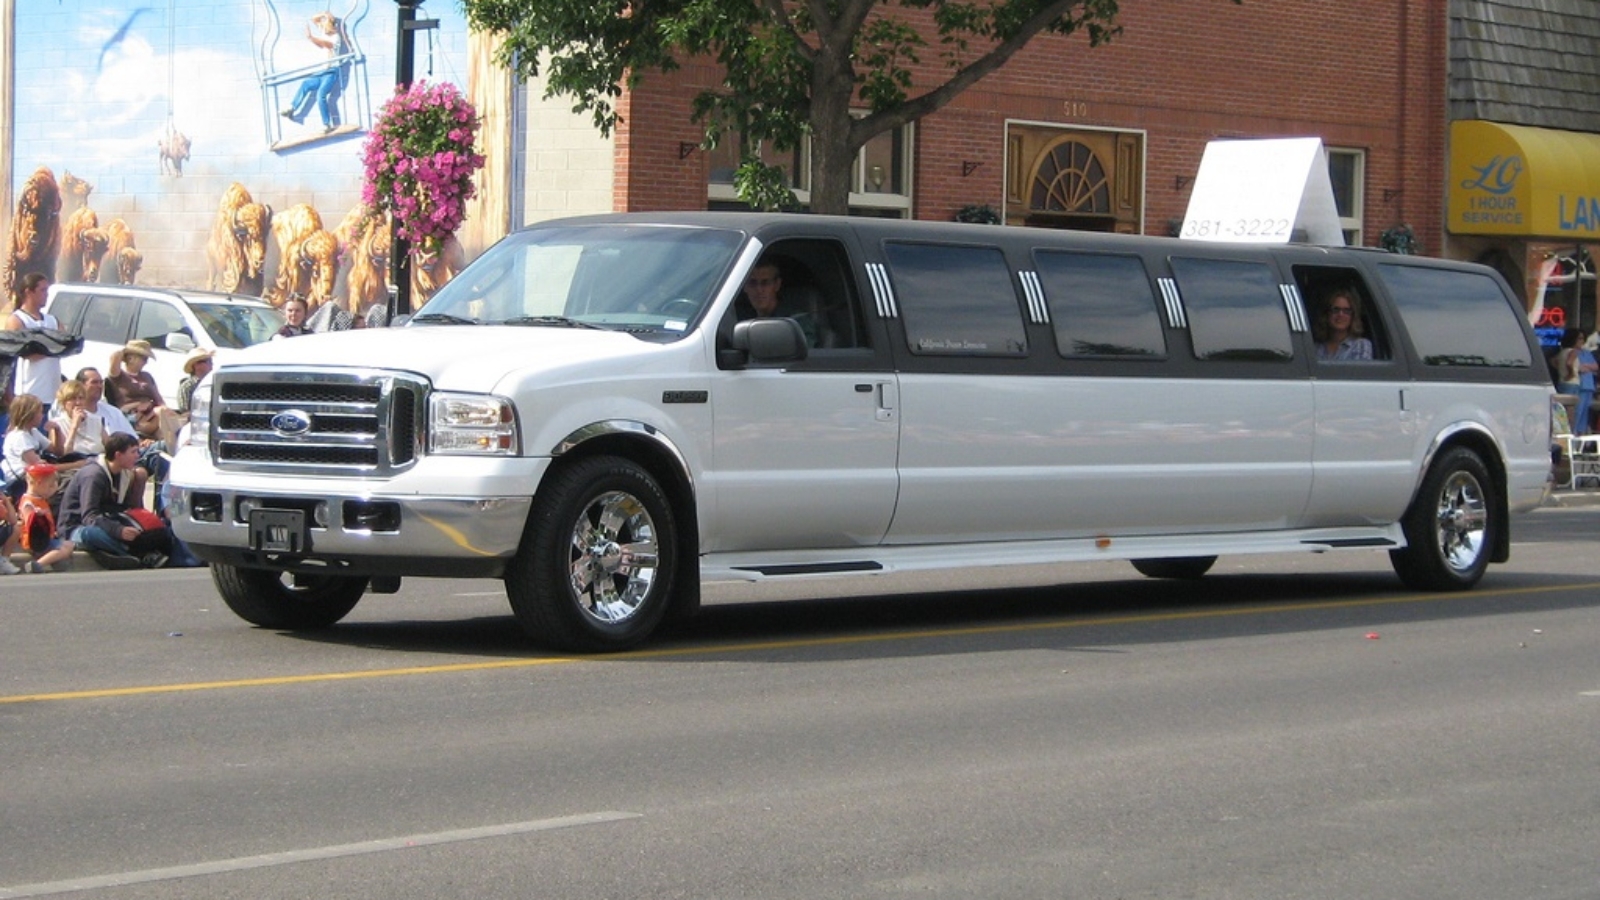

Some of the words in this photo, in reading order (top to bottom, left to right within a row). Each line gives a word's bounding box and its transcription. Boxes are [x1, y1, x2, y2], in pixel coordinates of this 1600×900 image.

[1063, 101, 1087, 117] 510
[1479, 197, 1517, 210] HOUR
[1462, 211, 1524, 224] SERVICE
[1184, 218, 1290, 237] 381-3222
